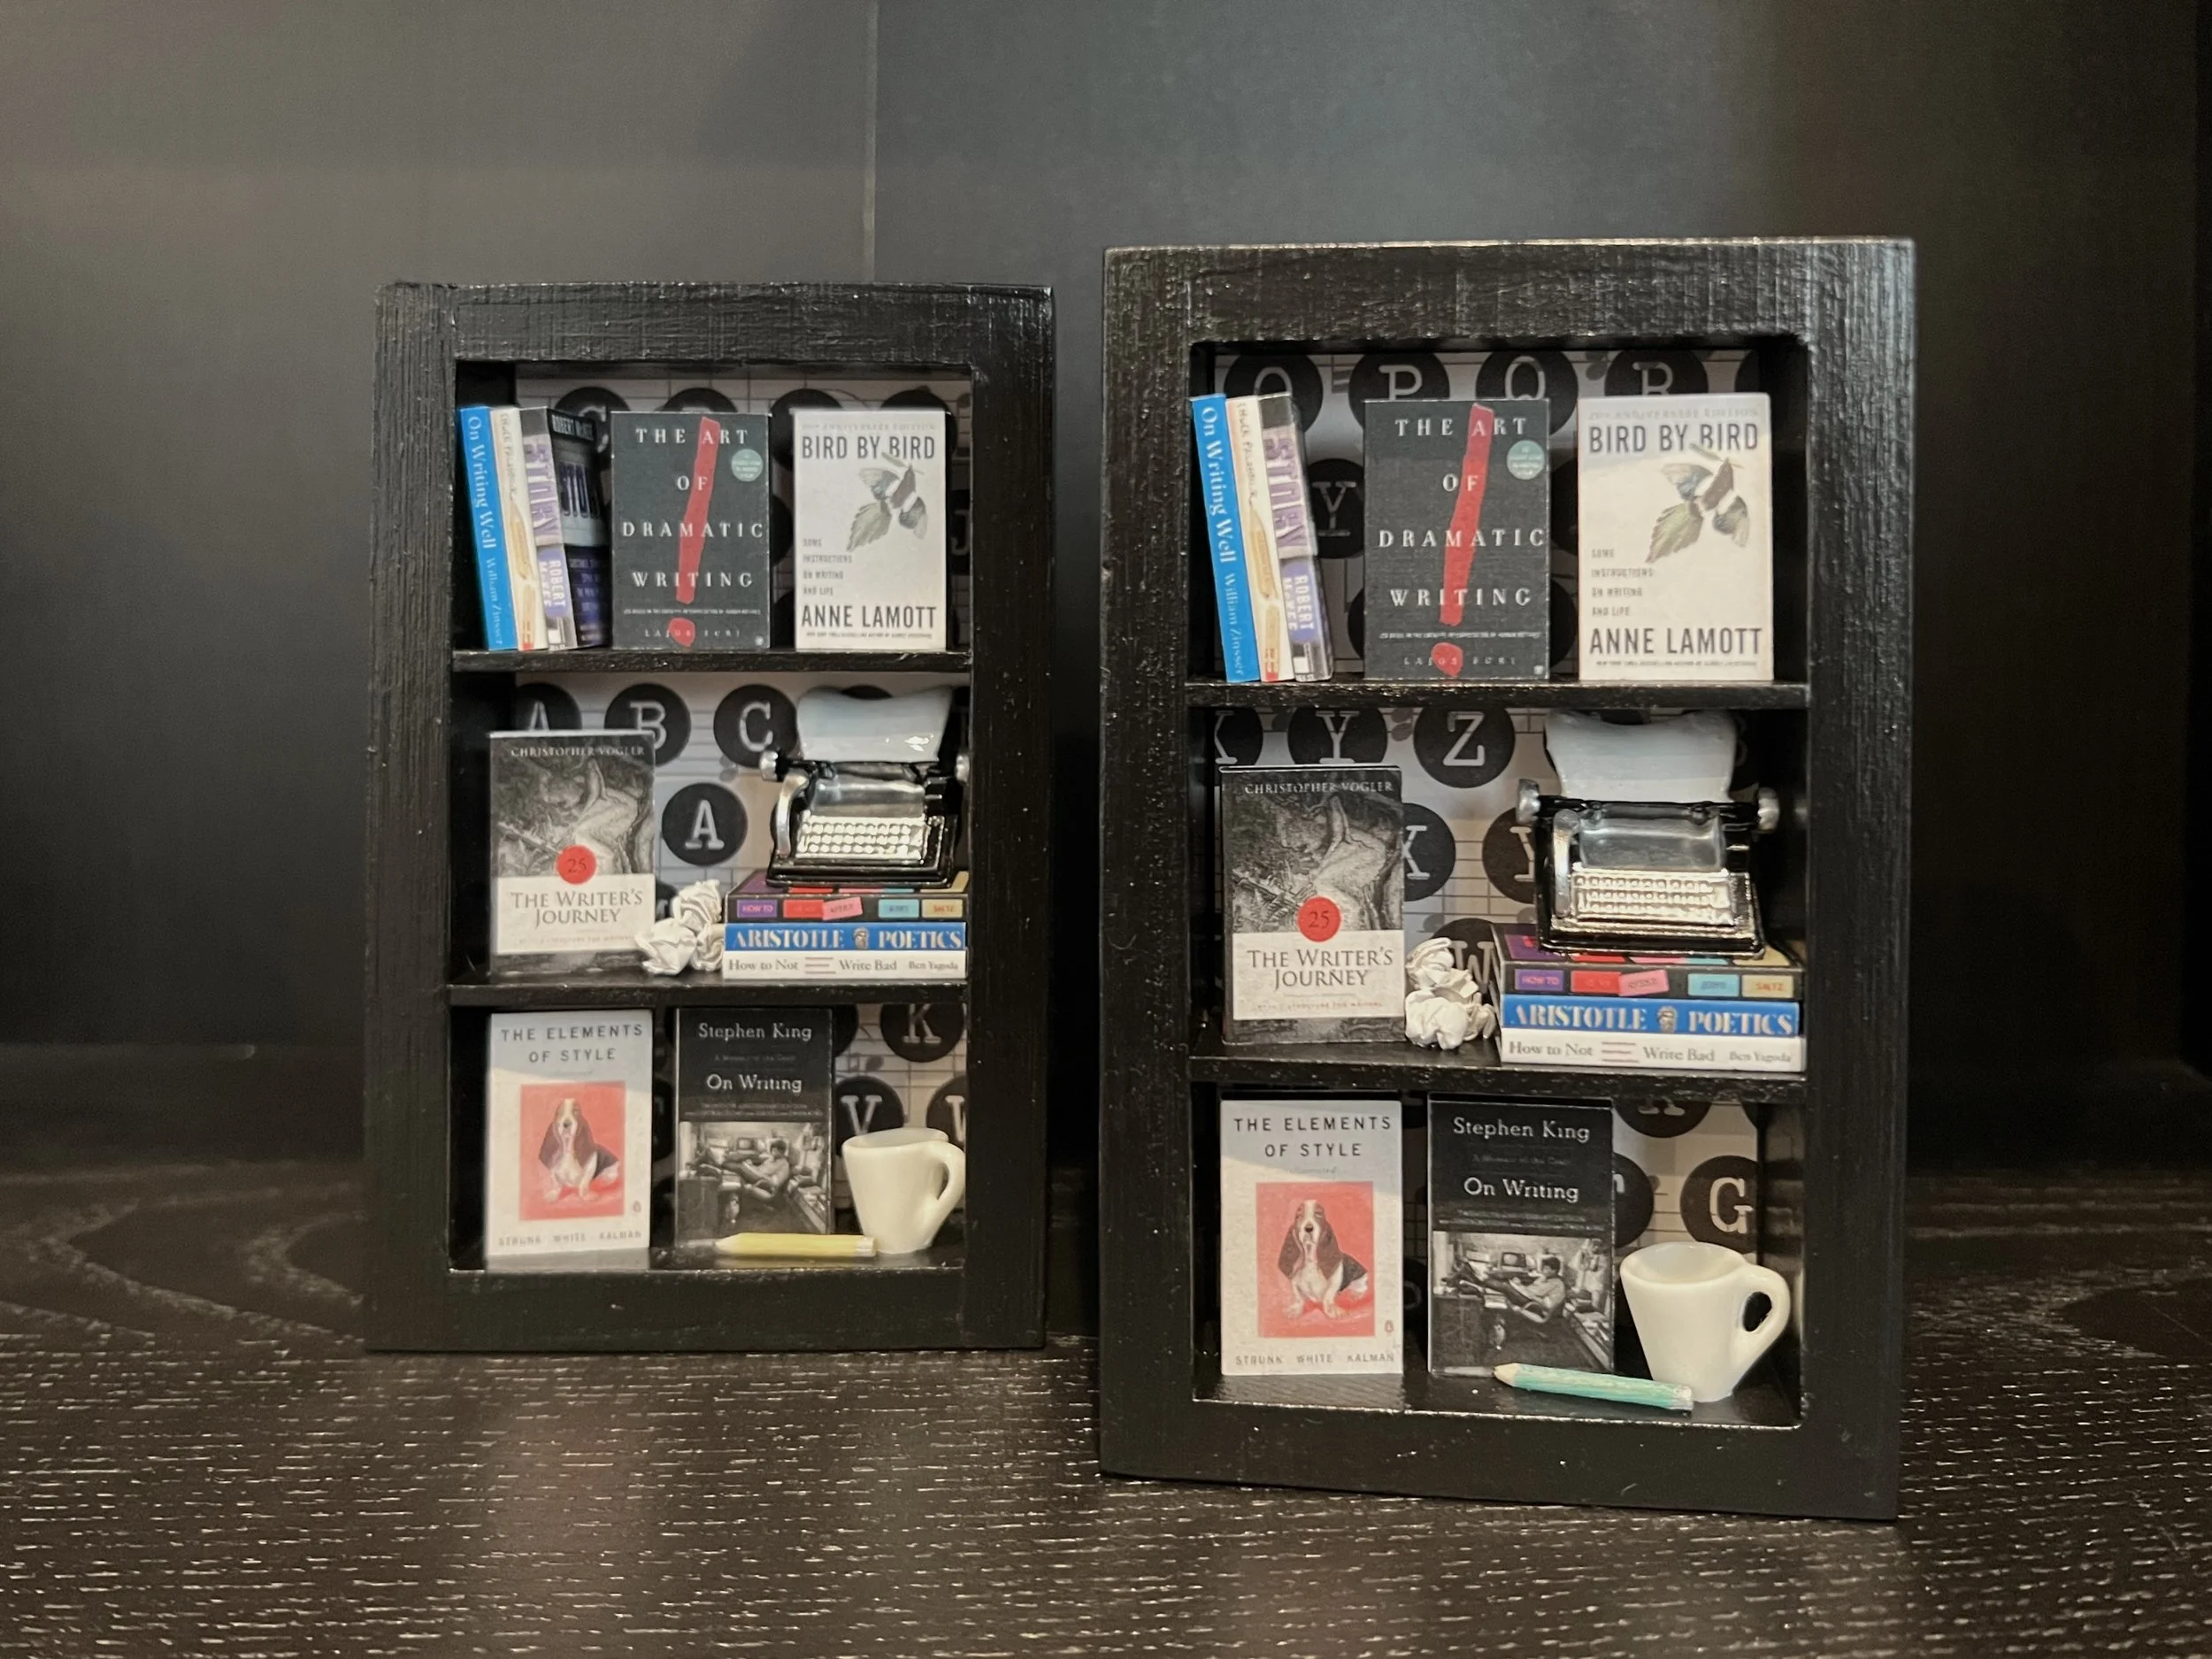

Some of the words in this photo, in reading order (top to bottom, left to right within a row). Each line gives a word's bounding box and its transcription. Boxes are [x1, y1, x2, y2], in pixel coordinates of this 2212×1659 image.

[468, 417, 481, 441] On
[1201, 406, 1218, 437] On
[1394, 418, 1454, 436] THE
[1471, 418, 1527, 436] ART
[635, 428, 686, 444] THE
[702, 428, 749, 444] ART
[802, 435, 848, 459] BIRD
[856, 435, 880, 459] BY
[888, 435, 935, 459] BIRD
[1589, 426, 1647, 454] BIRD
[1659, 424, 1688, 452] BY
[1699, 423, 1759, 451] BIRD
[472, 444, 489, 508] Writing
[677, 475, 709, 491] OF
[1206, 440, 1228, 516] Writing
[1442, 473, 1479, 492] OF
[1312, 481, 1357, 537] Y
[480, 511, 497, 549] Well
[622, 522, 764, 538] DRAMATIC
[1216, 518, 1237, 564] Well
[1378, 528, 1545, 548] DRAMATIC
[632, 572, 753, 588] WRITING
[1224, 572, 1240, 626] William
[1294, 575, 1315, 630] ROBERT
[1390, 588, 1532, 607] WRITING
[801, 605, 853, 628] ANNE
[862, 605, 937, 629] LAMOTT
[1589, 627, 1655, 655] ANNE
[1666, 627, 1763, 655] LAMOTT
[629, 700, 668, 750] B
[740, 702, 773, 752] C
[1316, 710, 1360, 764] Y
[1442, 711, 1486, 766] Z
[511, 746, 595, 757] CHRISTOPHER
[1244, 782, 1336, 795] CHRISTOPHER
[1340, 780, 1394, 794] VOGLER
[685, 800, 725, 850] A
[567, 857, 588, 874] 25
[510, 890, 549, 910] THE
[556, 887, 644, 908] WRITER'S
[534, 908, 623, 928] JOURNEY
[1308, 910, 1330, 928] 25
[733, 928, 845, 949] ARISTOTLE
[879, 929, 964, 949] POETICS
[728, 959, 758, 972] How
[760, 961, 772, 971] to
[775, 959, 799, 971] Not
[840, 959, 872, 972] Write
[874, 959, 897, 972] Bad
[909, 960, 926, 971] Ben
[1247, 949, 1289, 969] THE
[1296, 946, 1394, 967] WRITER'S
[1273, 969, 1371, 992] JOURNEY
[1544, 976, 1560, 986] TO
[1510, 1004, 1647, 1030] ARISTOTLE
[1688, 1010, 1794, 1036] POETICS
[501, 1028, 536, 1041] THE
[547, 1024, 643, 1040] ELEMENTS
[698, 1023, 765, 1042] Stephen
[772, 1023, 812, 1041] King
[528, 1049, 551, 1063] OF
[560, 1048, 617, 1062] STYLE
[1509, 1041, 1543, 1056] How
[1547, 1043, 1562, 1056] to
[1564, 1042, 1593, 1056] Not
[1642, 1046, 1684, 1061] Write
[1687, 1047, 1715, 1062] Bad
[1729, 1050, 1751, 1062] Ben
[706, 1074, 733, 1091] On
[739, 1073, 803, 1094] Writing
[1233, 1118, 1272, 1132] THE
[1284, 1117, 1392, 1132] ELEMENTS
[1452, 1116, 1534, 1140] Stephen
[1542, 1120, 1590, 1144] King
[1264, 1143, 1289, 1157] OF
[1300, 1142, 1363, 1157] STYLE
[1463, 1176, 1495, 1197] On
[1502, 1178, 1579, 1203] Writing
[1709, 1178, 1754, 1234] G
[1234, 1355, 1283, 1366] STRUNK
[1296, 1354, 1333, 1364] WHITE
[1347, 1353, 1395, 1363] KALMAN
